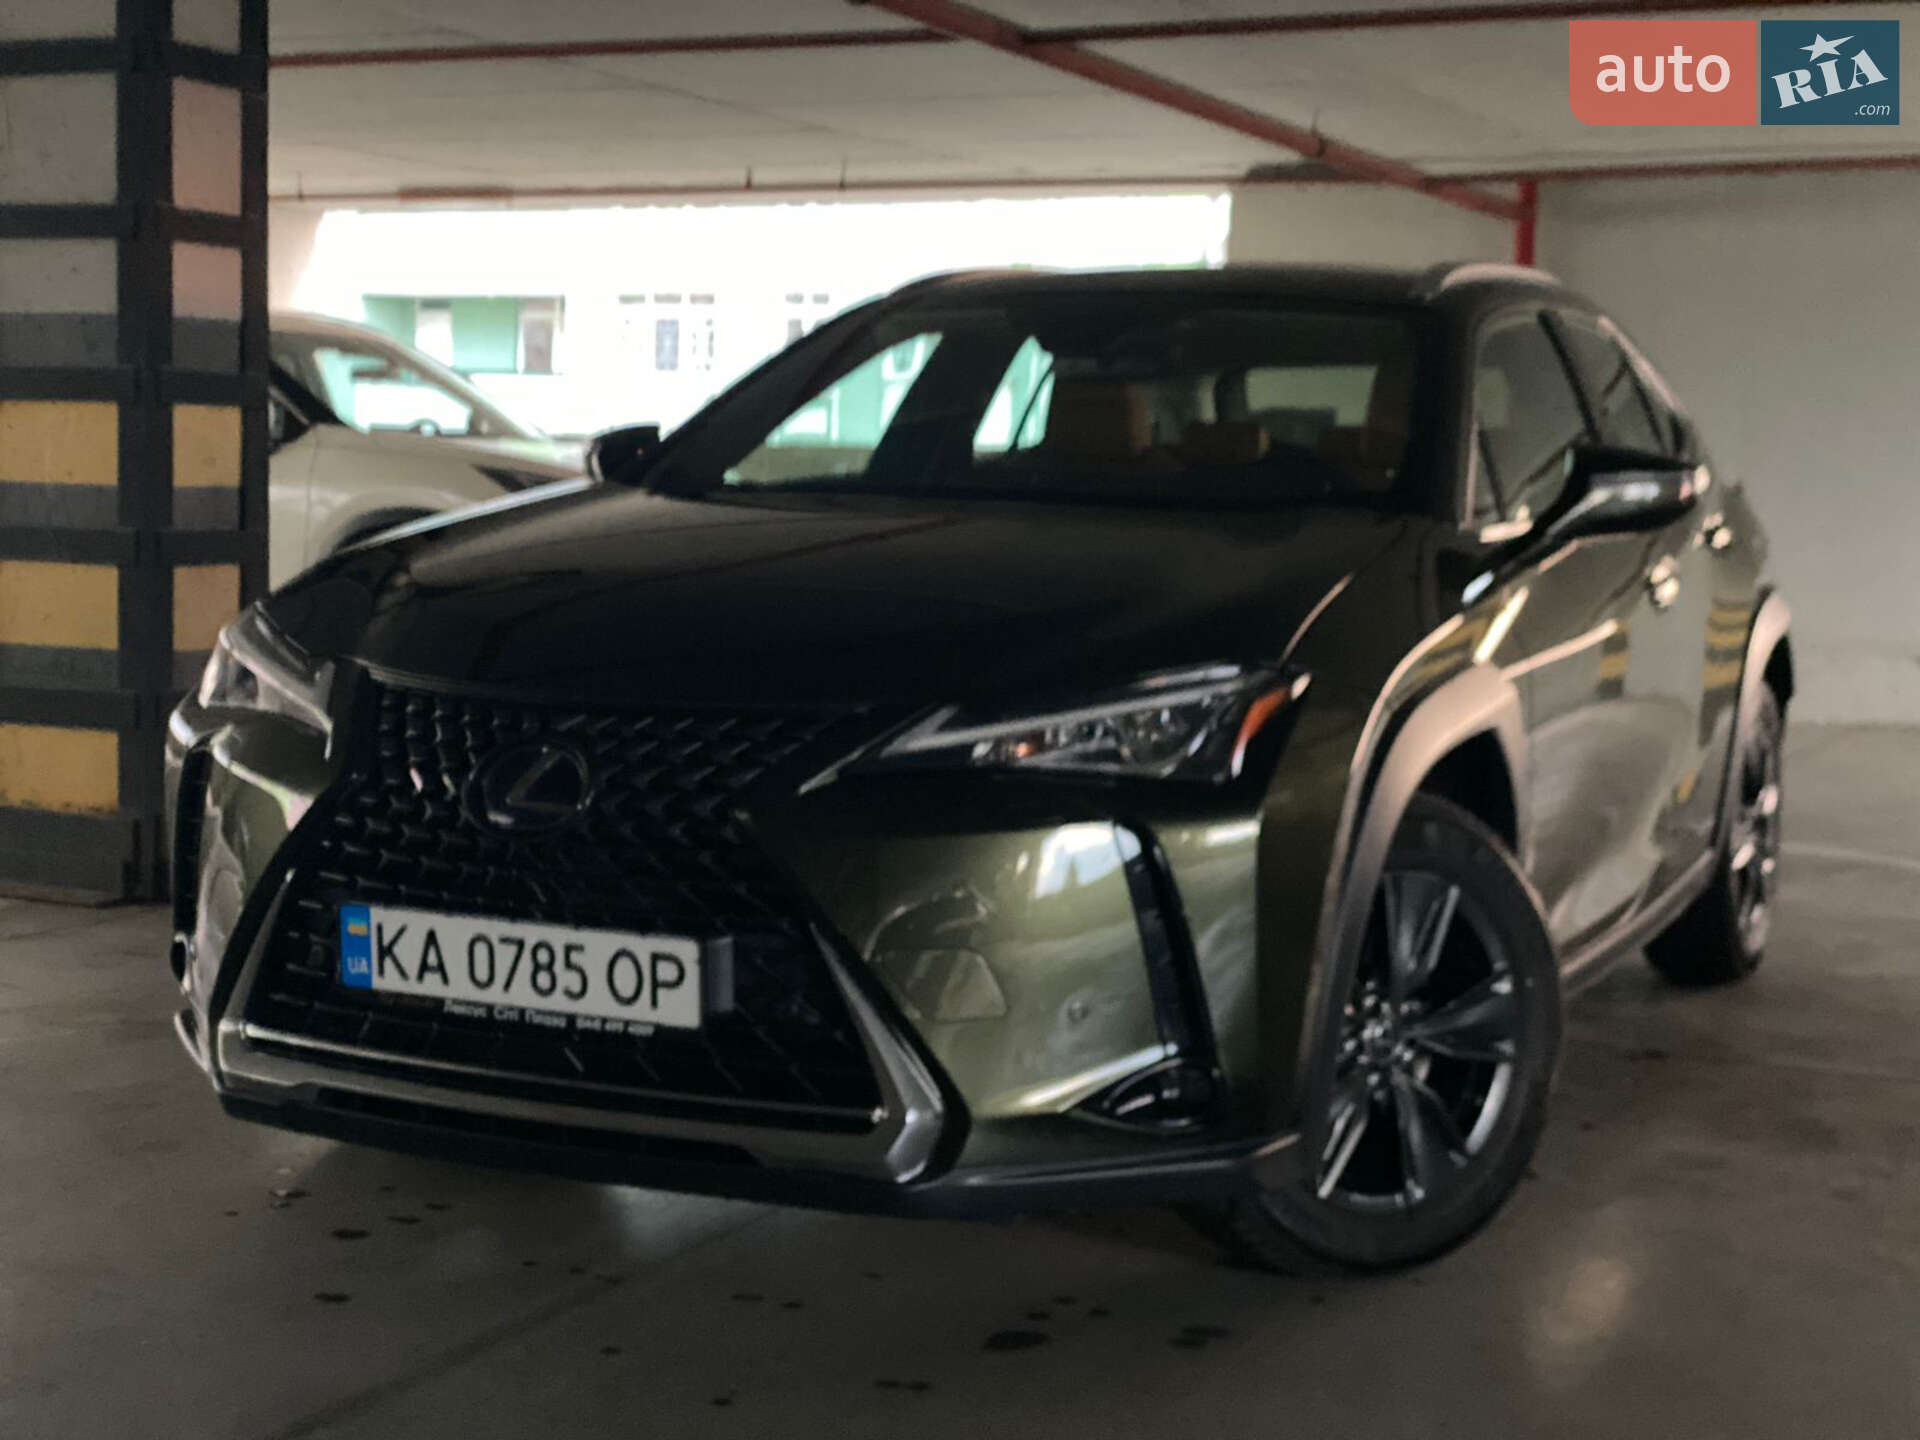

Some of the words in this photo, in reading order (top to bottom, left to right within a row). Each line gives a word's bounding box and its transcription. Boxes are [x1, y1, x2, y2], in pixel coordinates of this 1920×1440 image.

[347, 956, 369, 974] UA
[375, 921, 450, 986] KA
[468, 932, 588, 1001] 0785
[606, 948, 686, 1011] OP
